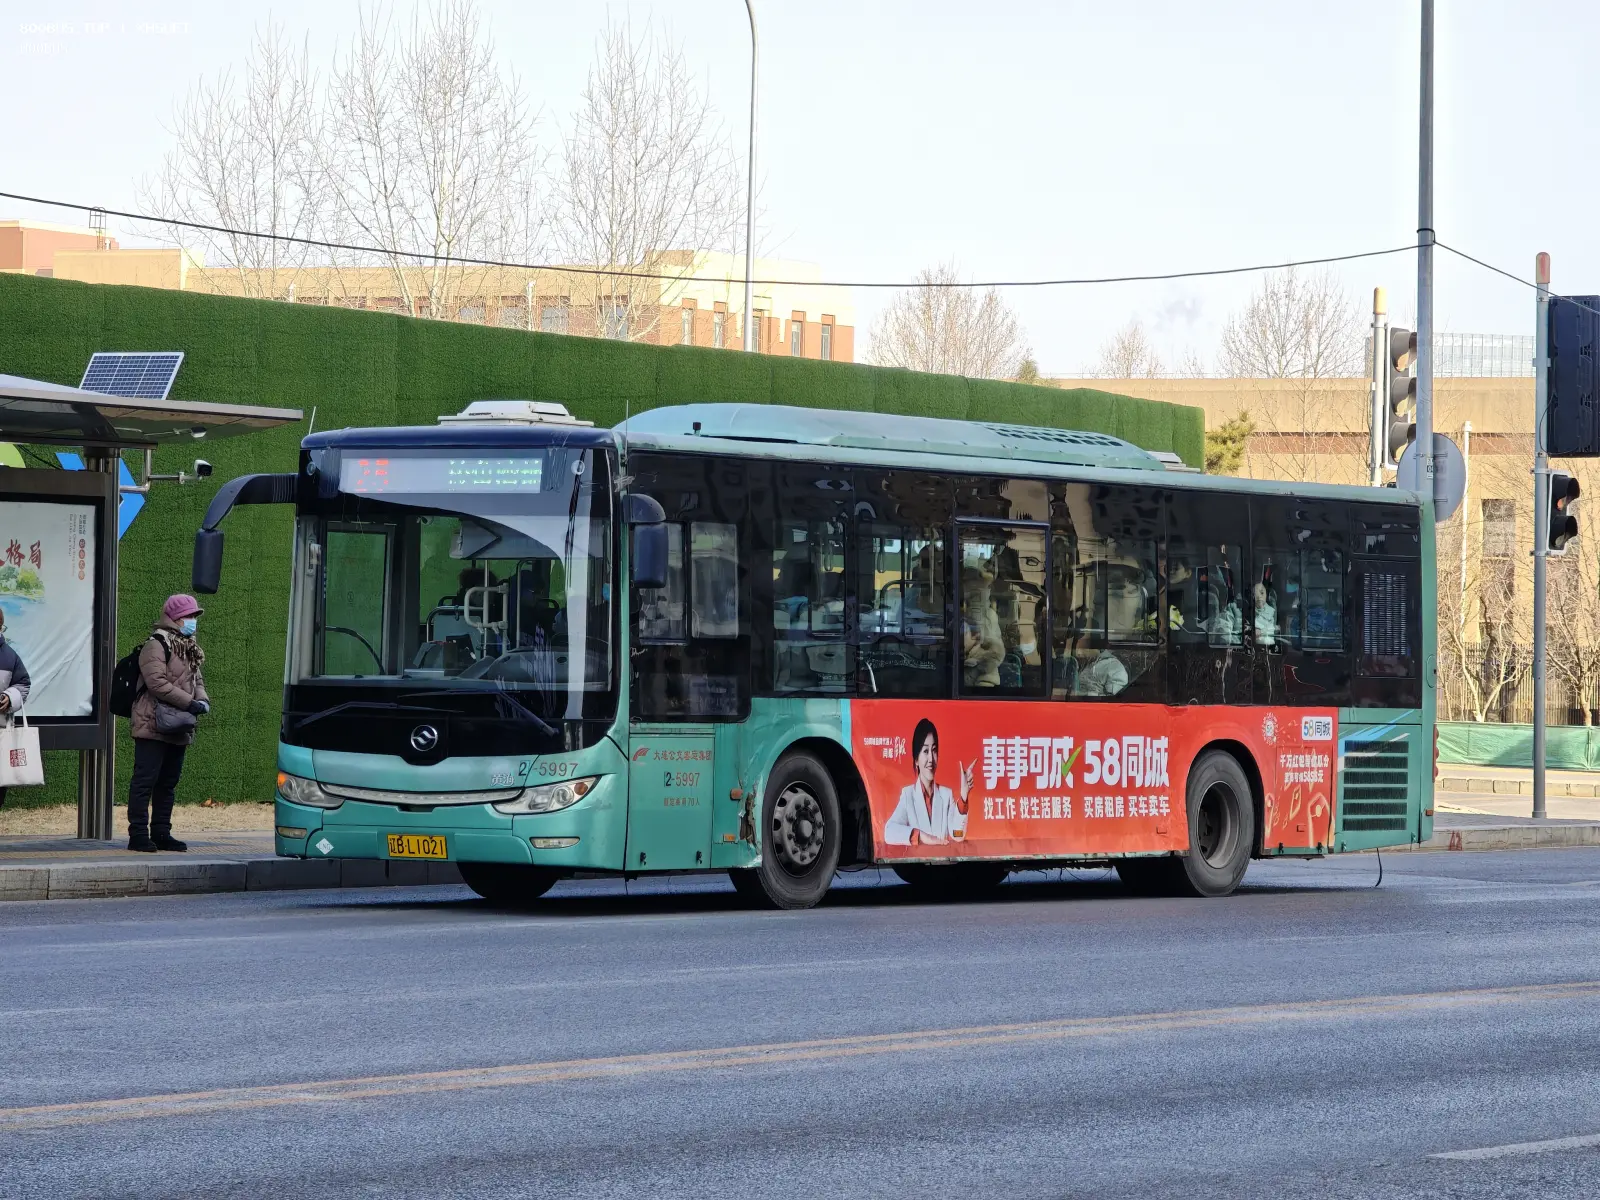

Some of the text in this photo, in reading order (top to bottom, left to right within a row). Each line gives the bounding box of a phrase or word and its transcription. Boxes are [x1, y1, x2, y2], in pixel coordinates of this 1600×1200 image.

[0, 539, 42, 569] 格局
[1303, 719, 1331, 737] 58同城
[517, 761, 579, 778] 2-5997
[983, 735, 1074, 790] 事事可成
[1084, 735, 1169, 788] 58同城
[665, 772, 701, 787] 2-5997
[984, 794, 1171, 819] 找工作 找生活服务 买房租房 买车卖车
